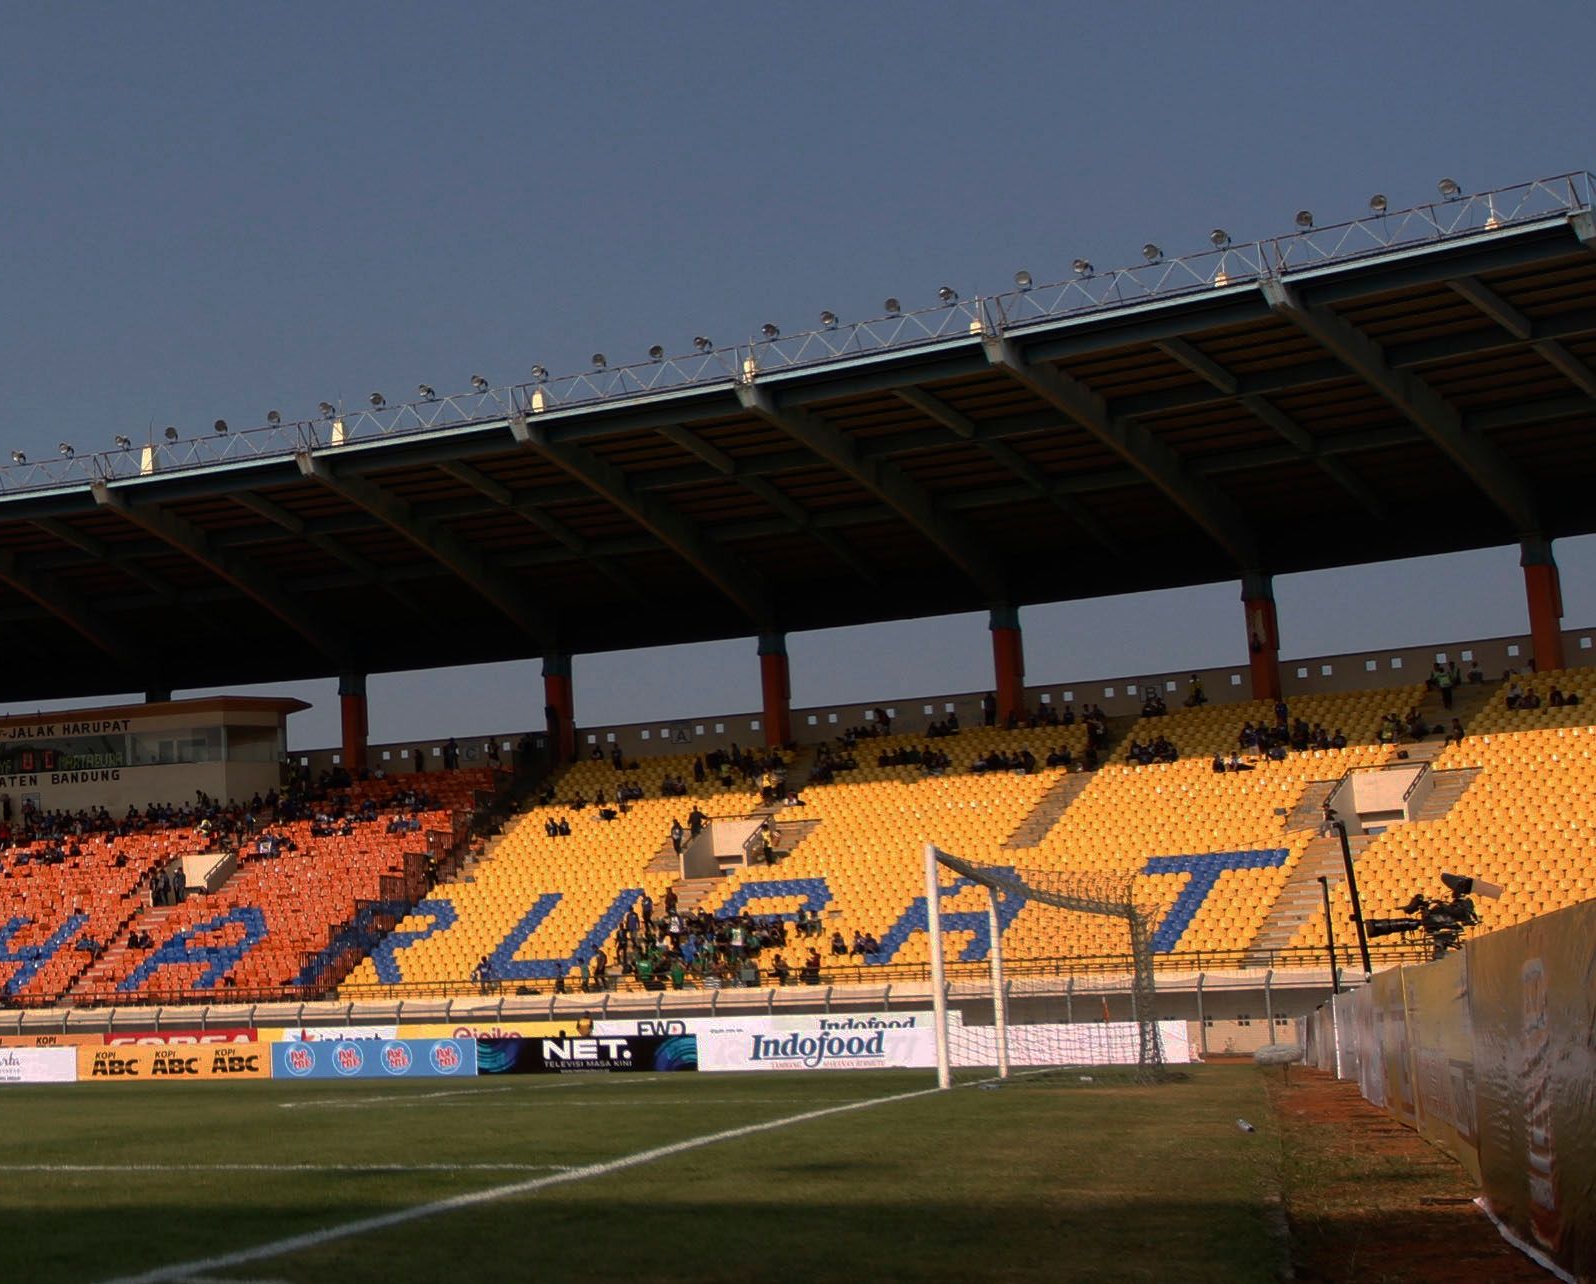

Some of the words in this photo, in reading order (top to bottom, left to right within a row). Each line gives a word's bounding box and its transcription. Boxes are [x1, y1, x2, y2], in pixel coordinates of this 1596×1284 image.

[9, 725, 54, 739] JALAK
[63, 720, 131, 735] HARUPAT
[51, 770, 120, 785] BANDUNG
[36, 1036, 57, 1045] KOPI
[95, 1051, 117, 1060] KOPI
[154, 1050, 176, 1059] KOPI
[214, 1048, 236, 1057] KOPI
[748, 1030, 886, 1068] Indofood
[92, 1059, 139, 1076] ABC
[151, 1058, 198, 1075] ABC
[211, 1055, 259, 1073] ABC
[544, 1060, 584, 1068] TELEVISI
